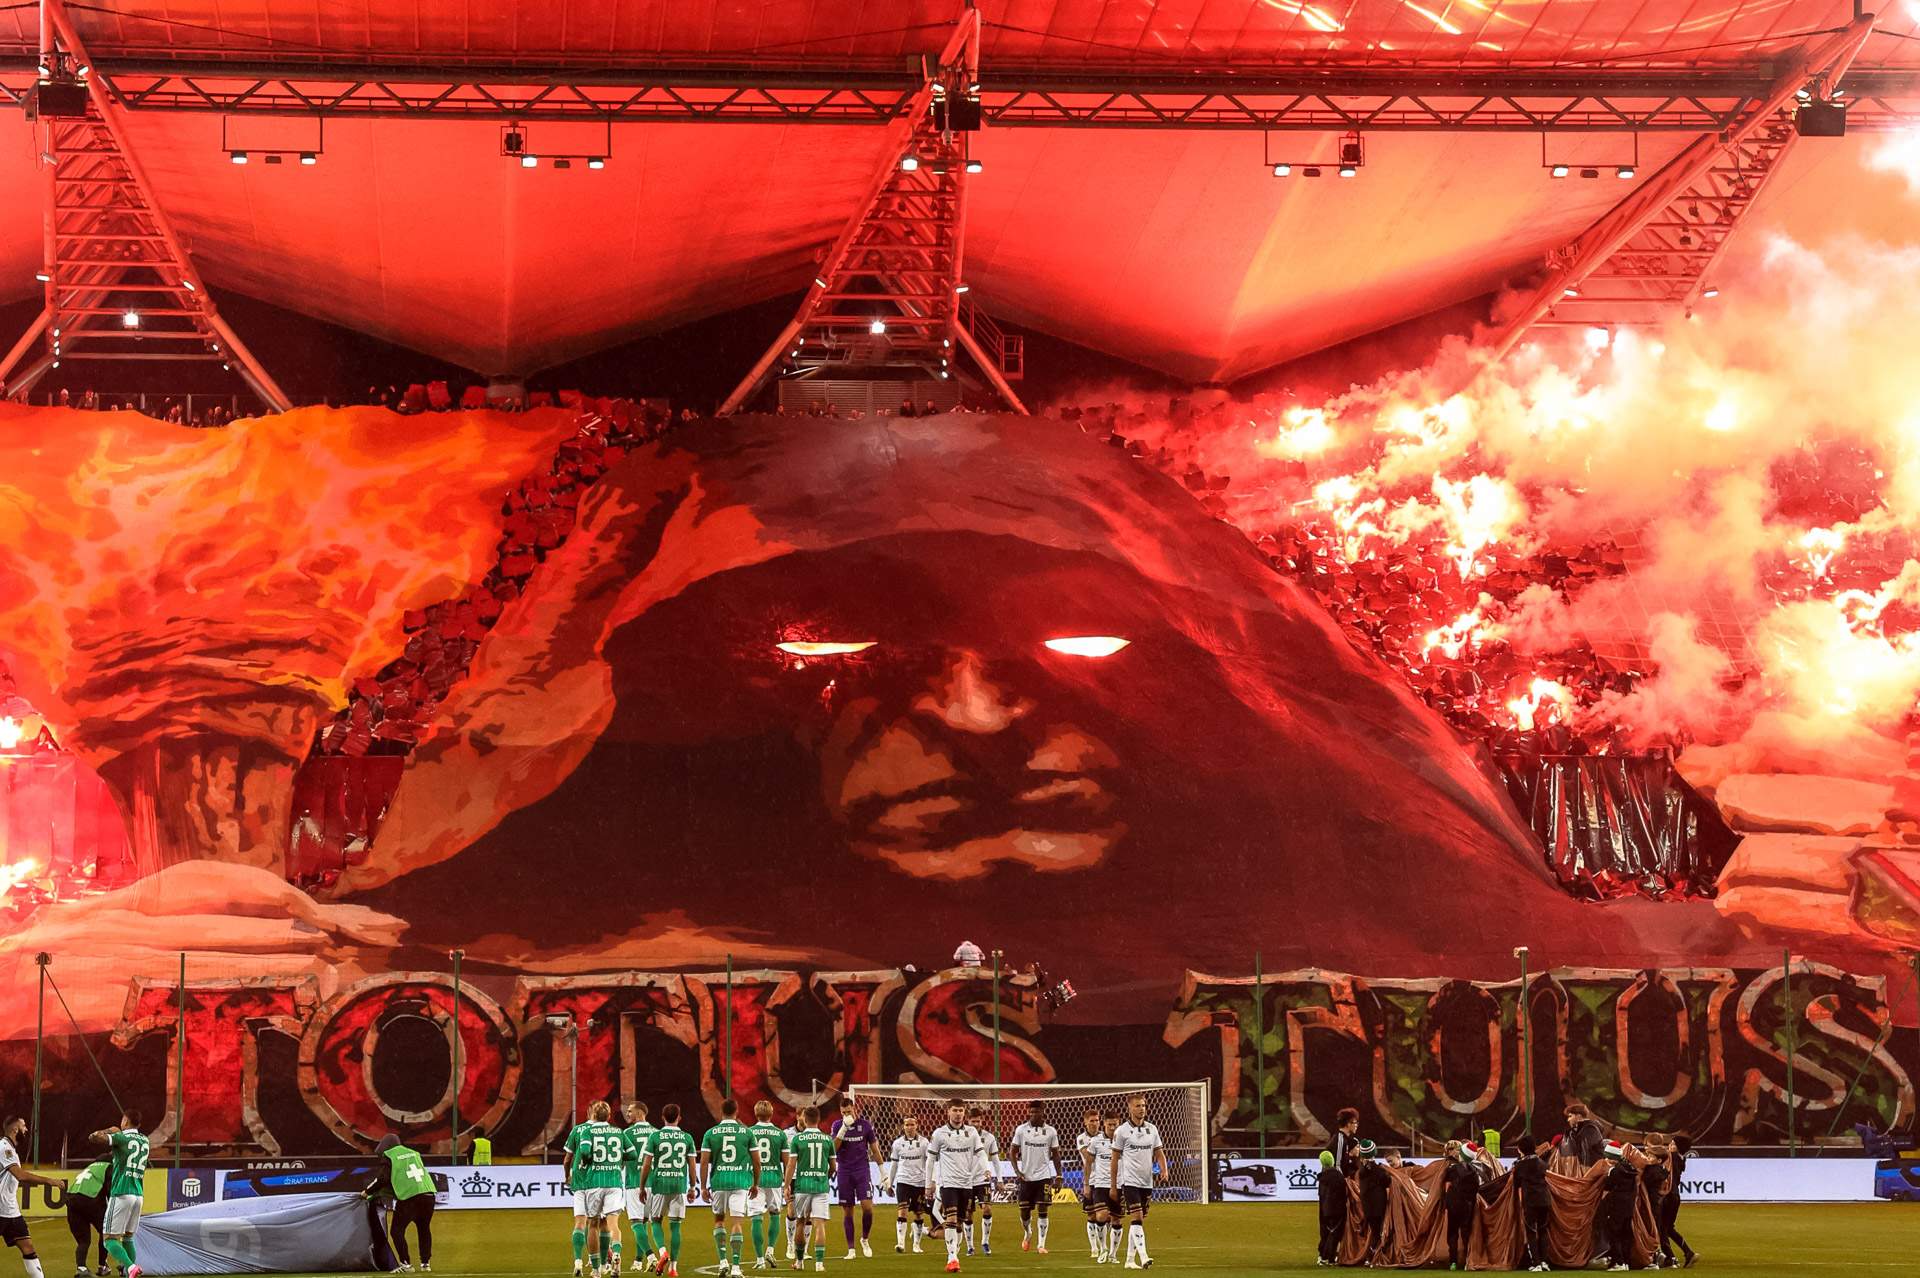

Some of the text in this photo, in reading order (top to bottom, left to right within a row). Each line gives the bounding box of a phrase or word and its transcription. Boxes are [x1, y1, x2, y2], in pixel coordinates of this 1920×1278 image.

[111, 958, 1914, 1156] TOTUS TUUS
[126, 1140, 150, 1171] 22
[592, 1136, 622, 1163] 53
[636, 1136, 649, 1163] 7
[657, 1142, 687, 1169] 23
[721, 1135, 737, 1163] 5
[758, 1137, 771, 1163] 8
[807, 1142, 823, 1169] 11
[497, 1182, 541, 1197] RAF
[1680, 1181, 1725, 1194] NYCH
